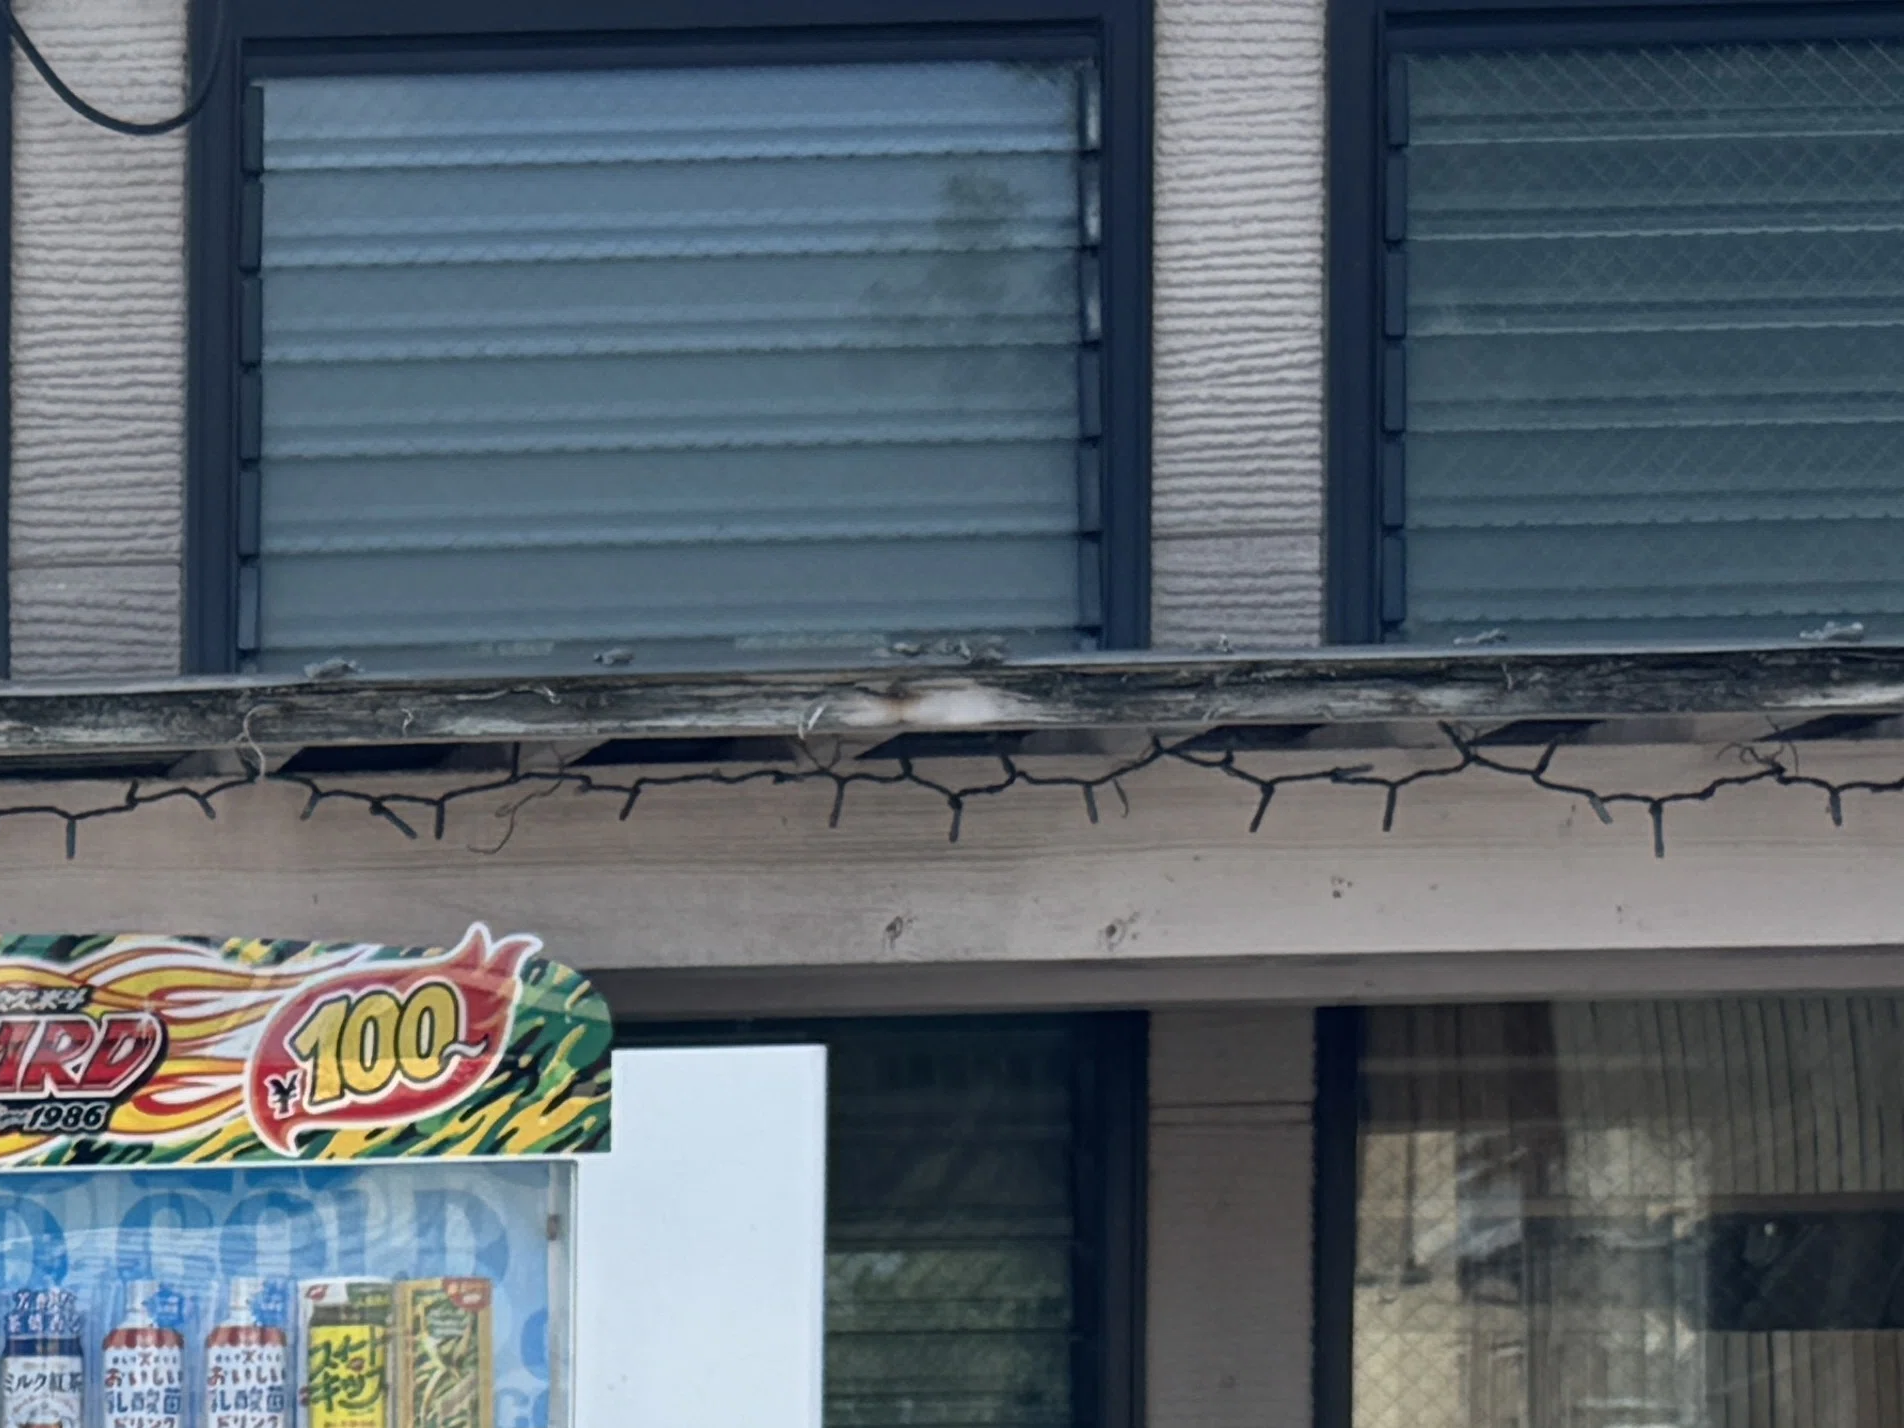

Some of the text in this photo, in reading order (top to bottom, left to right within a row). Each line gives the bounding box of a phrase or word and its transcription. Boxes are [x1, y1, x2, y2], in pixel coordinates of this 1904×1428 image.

[4, 1372, 82, 1394] ミルク紅茶
[105, 1368, 184, 1388] おいしい
[207, 1366, 286, 1387] おいしい
[105, 1387, 181, 1415] 乳酸菌
[208, 1386, 285, 1414] 乳酸菌
